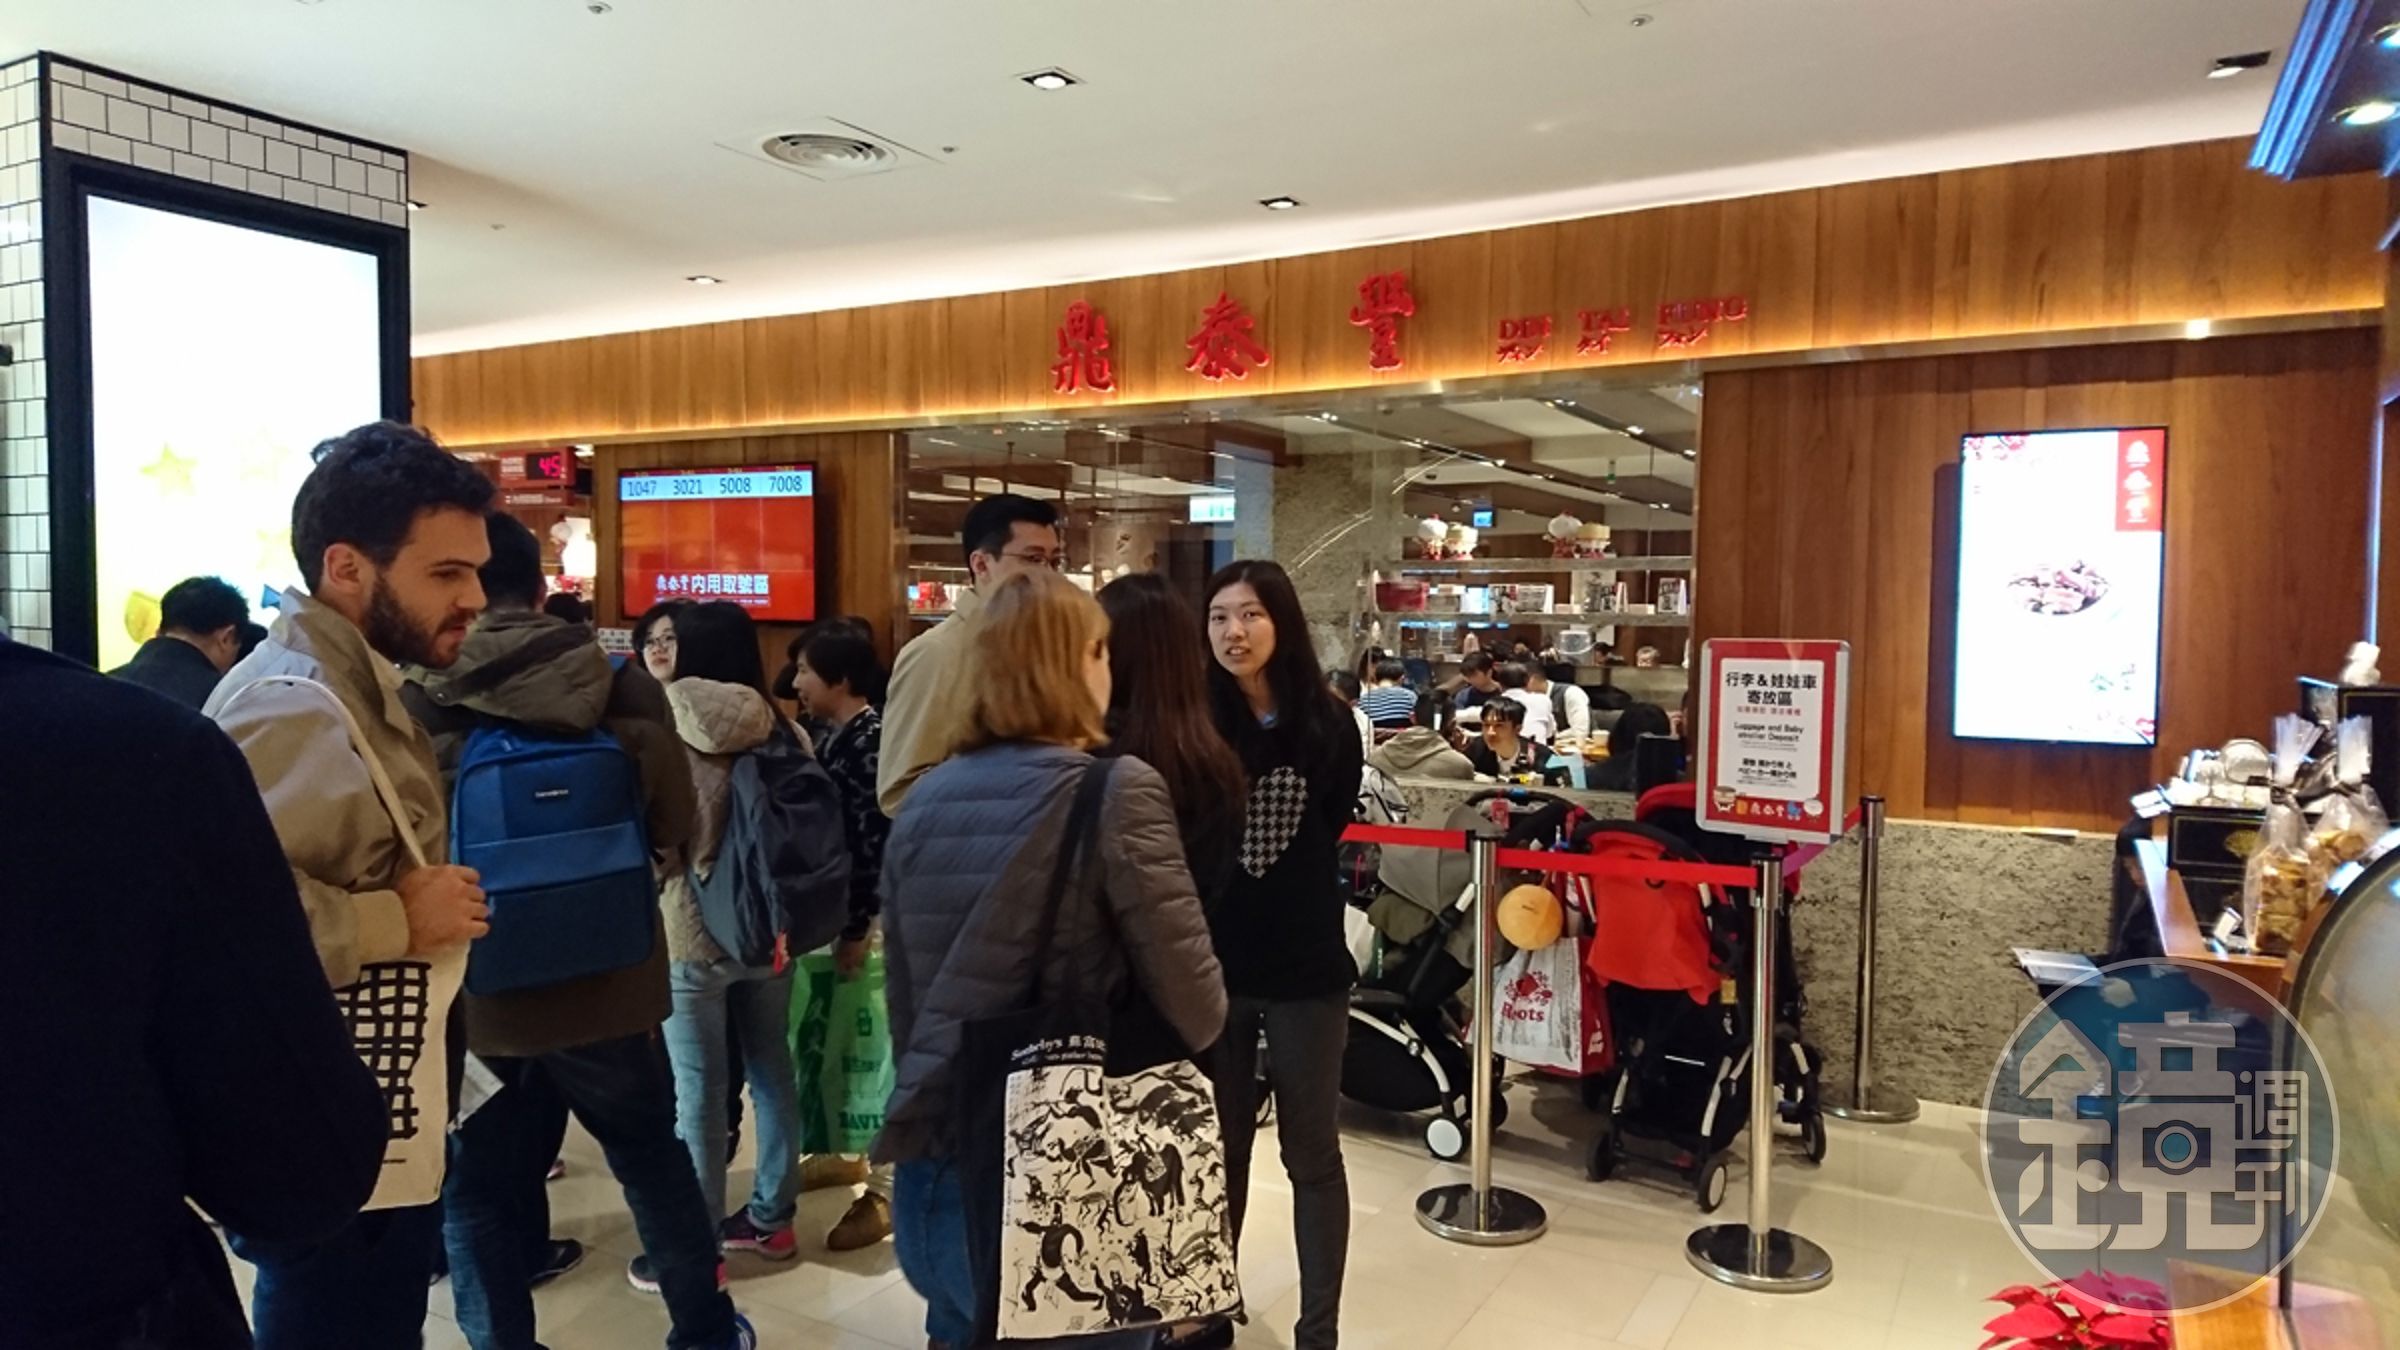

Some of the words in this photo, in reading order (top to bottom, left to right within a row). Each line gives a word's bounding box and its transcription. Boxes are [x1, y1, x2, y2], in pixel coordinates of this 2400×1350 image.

[1498, 314, 1552, 340] DIN
[1577, 307, 1631, 332] TAI
[1657, 296, 1748, 326] FUNG
[538, 455, 561, 477] 45
[627, 480, 658, 496] 1047
[672, 479, 704, 495] 3021
[720, 477, 752, 494] 5008
[768, 475, 803, 492] 7008
[1748, 690, 1792, 705] 寄放區
[1734, 722, 1766, 732] Luggage
[1767, 724, 1782, 732] and
[1784, 724, 1804, 734] Baby
[1768, 733, 1800, 743] Deposit
